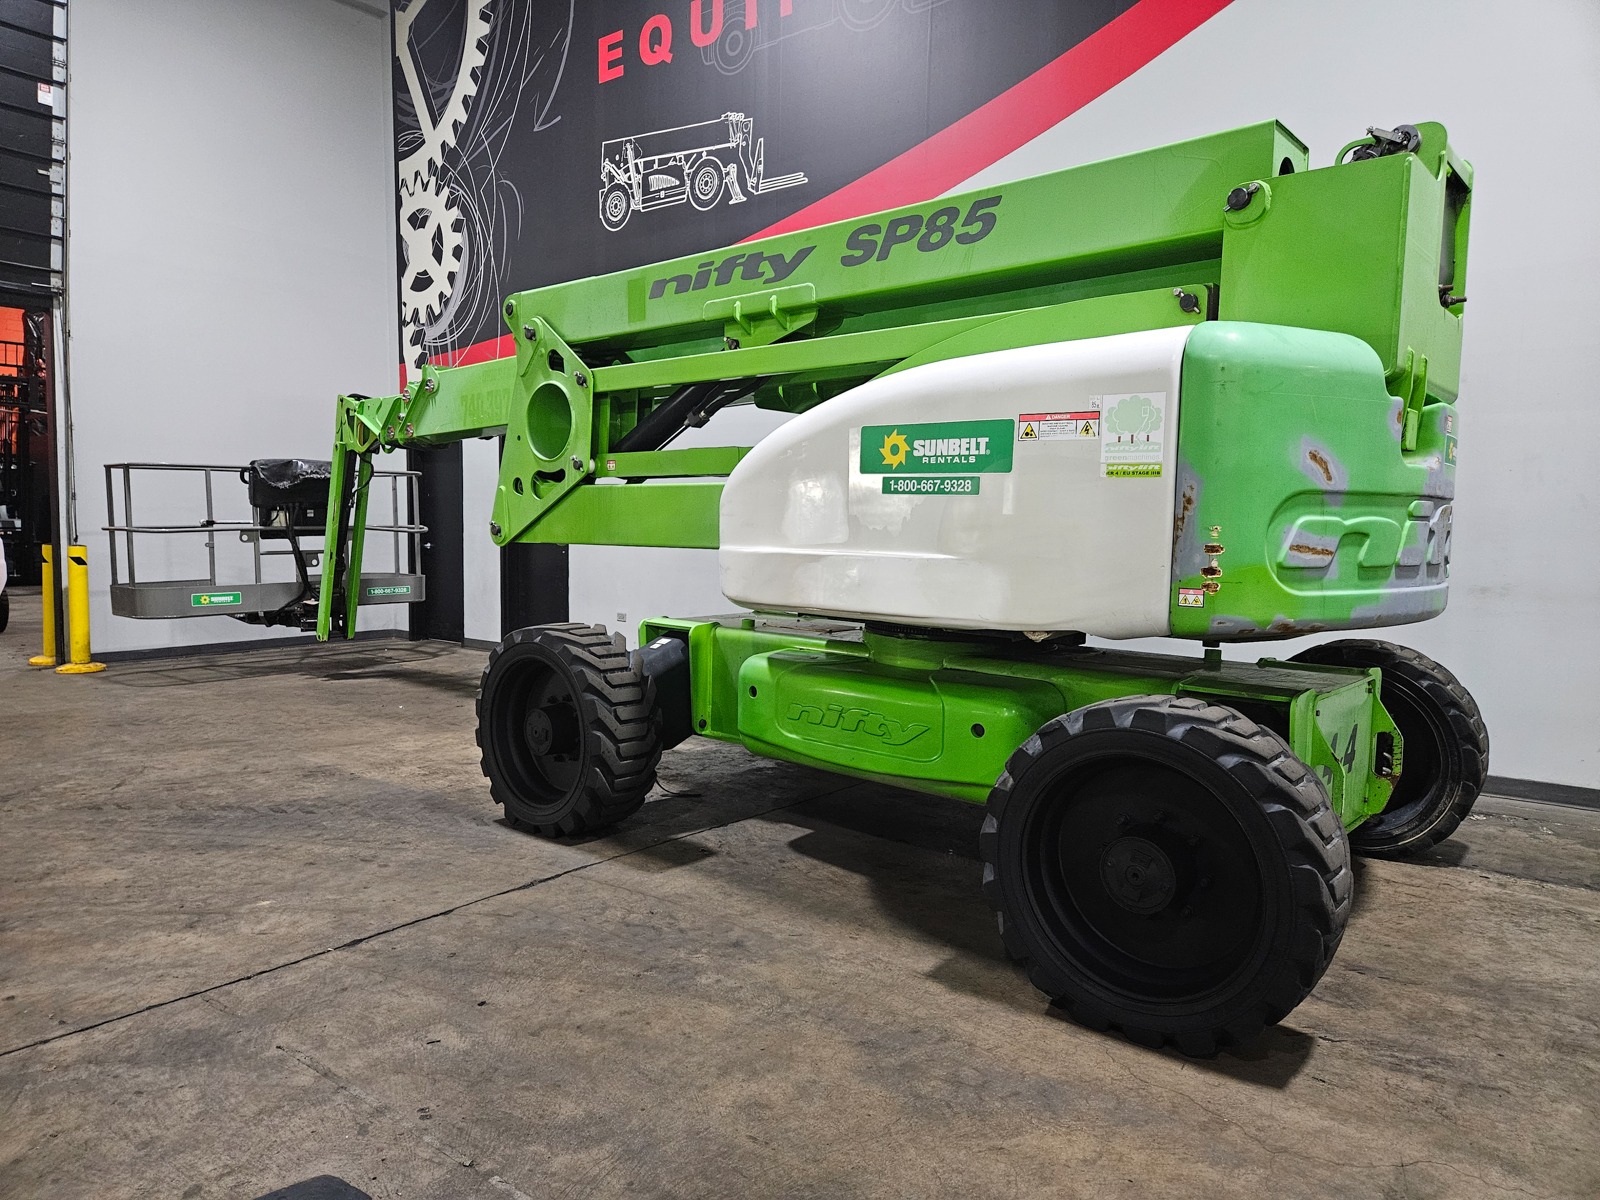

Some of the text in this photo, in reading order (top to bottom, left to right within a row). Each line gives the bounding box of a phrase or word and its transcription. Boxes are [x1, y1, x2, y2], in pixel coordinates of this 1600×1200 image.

[649, 195, 1002, 299] nifty SP85
[913, 437, 990, 457] SUNBELT
[922, 456, 976, 464] RENTALS
[889, 479, 972, 492] 1-800-667-9328
[787, 702, 930, 746] nifty
